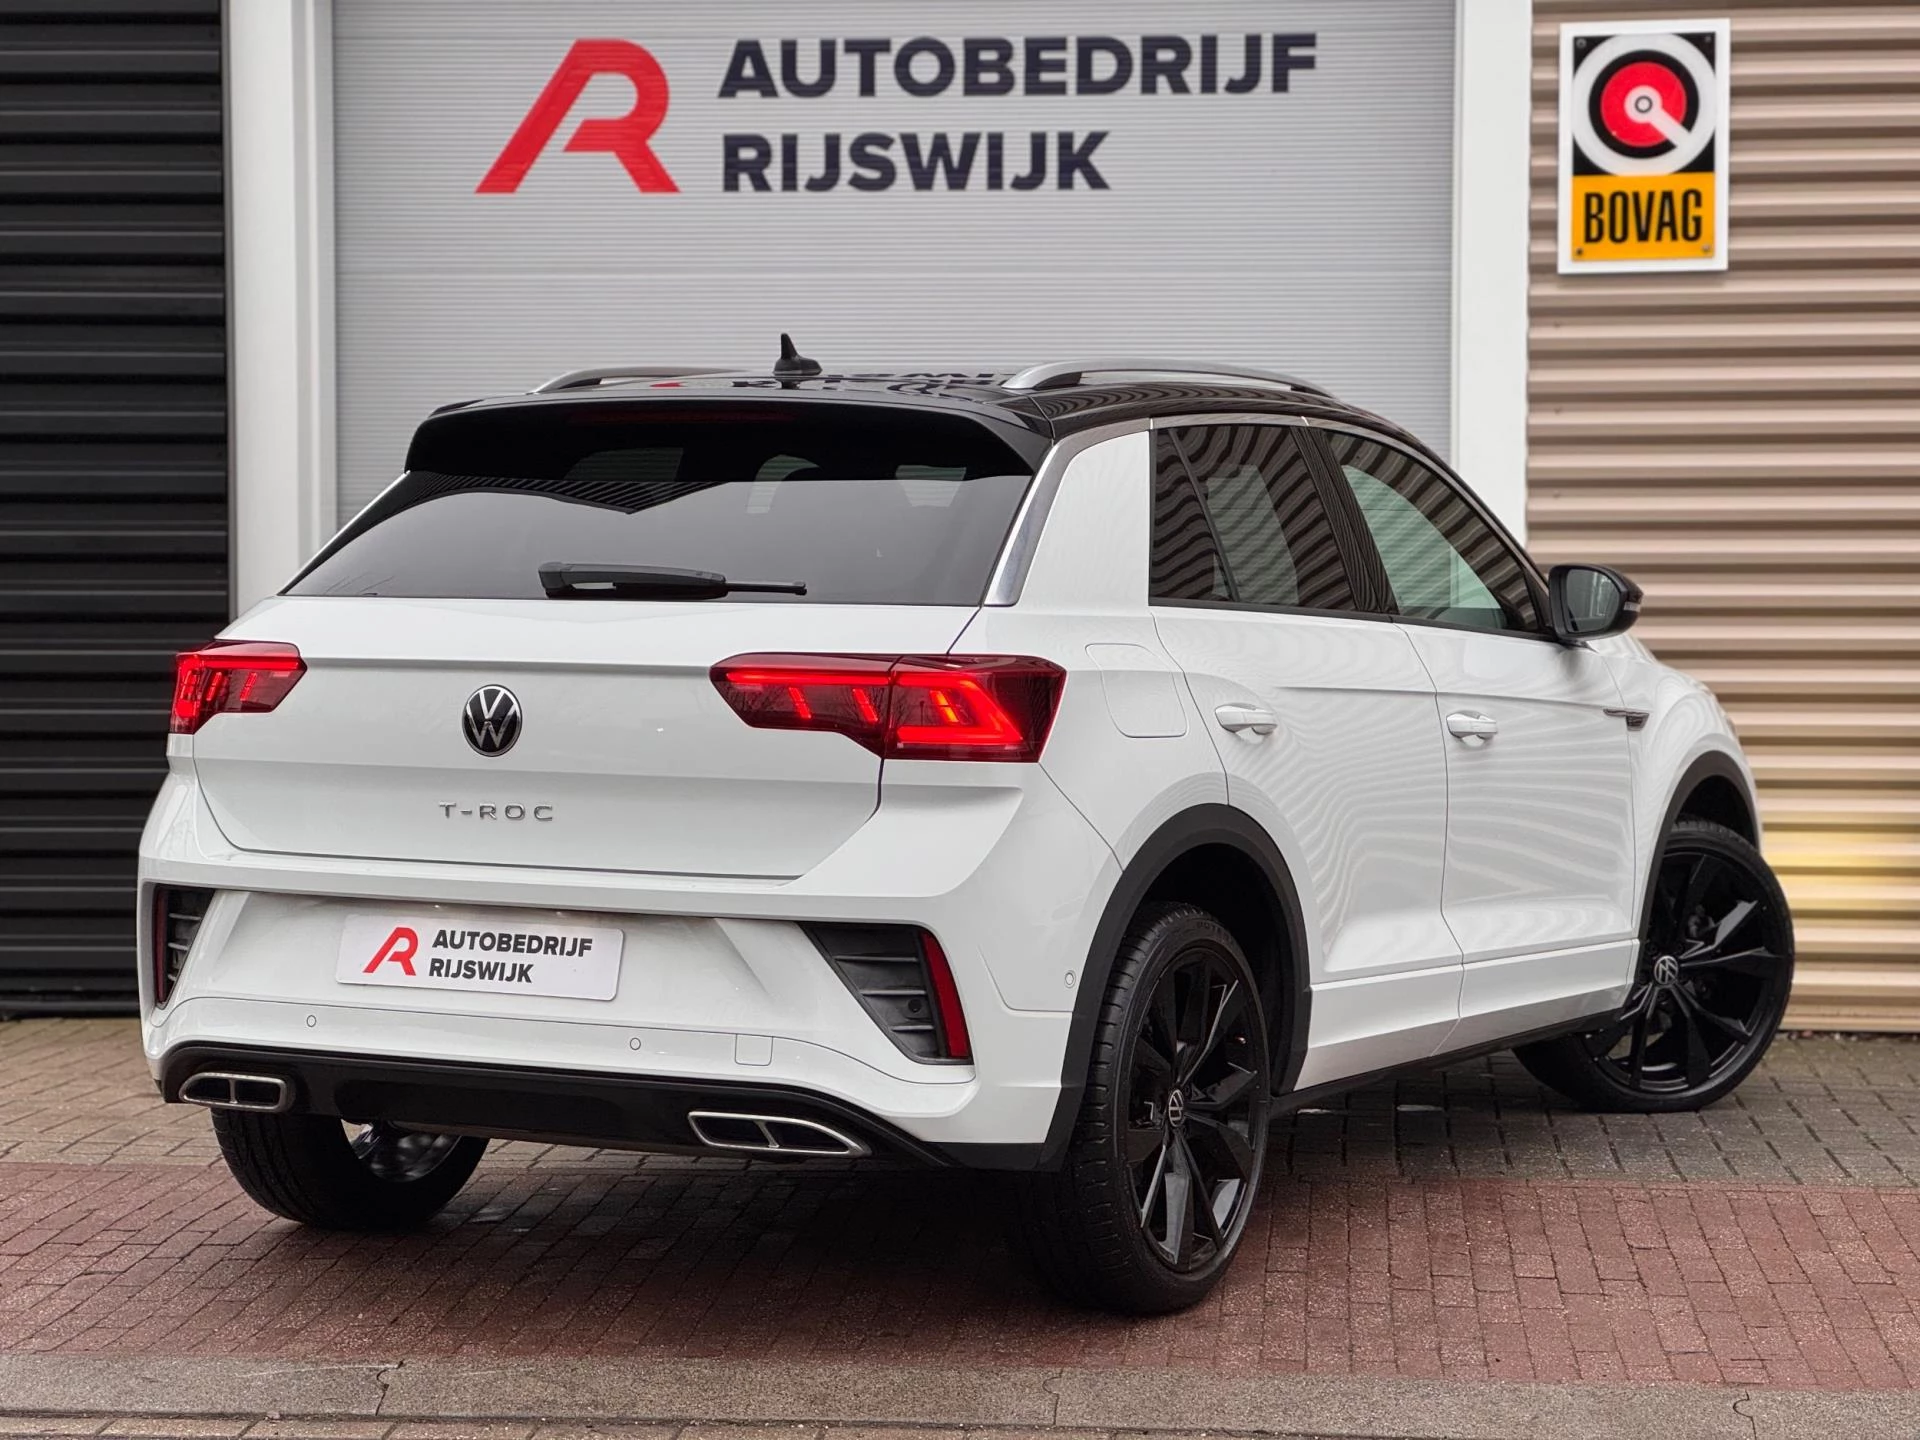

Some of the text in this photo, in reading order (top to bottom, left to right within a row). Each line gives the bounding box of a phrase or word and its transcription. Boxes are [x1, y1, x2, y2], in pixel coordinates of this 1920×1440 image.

[718, 33, 1317, 99] AUTOBEDRIJF
[723, 131, 1110, 192] RIJSWIJK
[1584, 188, 1703, 243] BOVAG
[439, 800, 554, 822] T-ROC
[432, 929, 593, 957] AUTOBEDRIJF
[429, 958, 534, 983] RIJSWIJK
